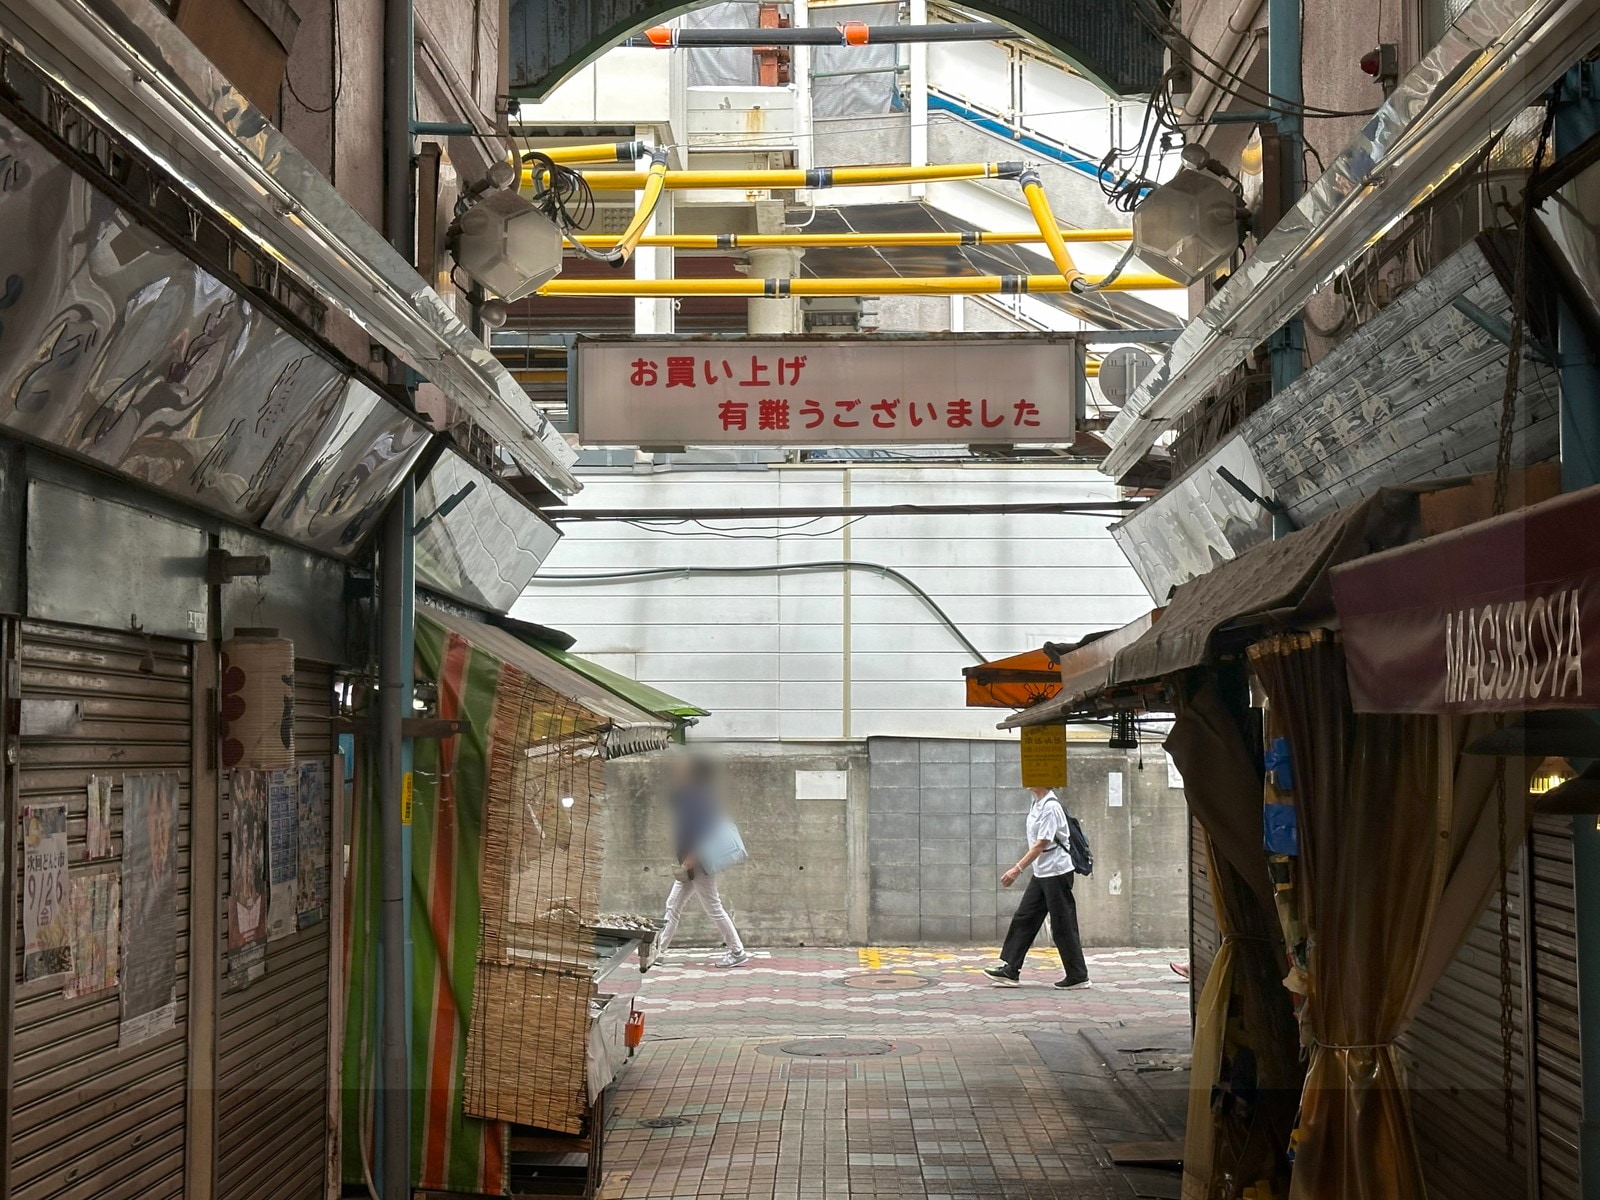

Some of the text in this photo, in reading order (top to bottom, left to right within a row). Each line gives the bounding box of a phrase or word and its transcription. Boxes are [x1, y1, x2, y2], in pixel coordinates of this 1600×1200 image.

[630, 356, 807, 388] お買い上げ
[717, 399, 1041, 431] 有難うございました
[1444, 588, 1583, 703] MAGUROYA
[28, 869, 63, 910] 9/26
